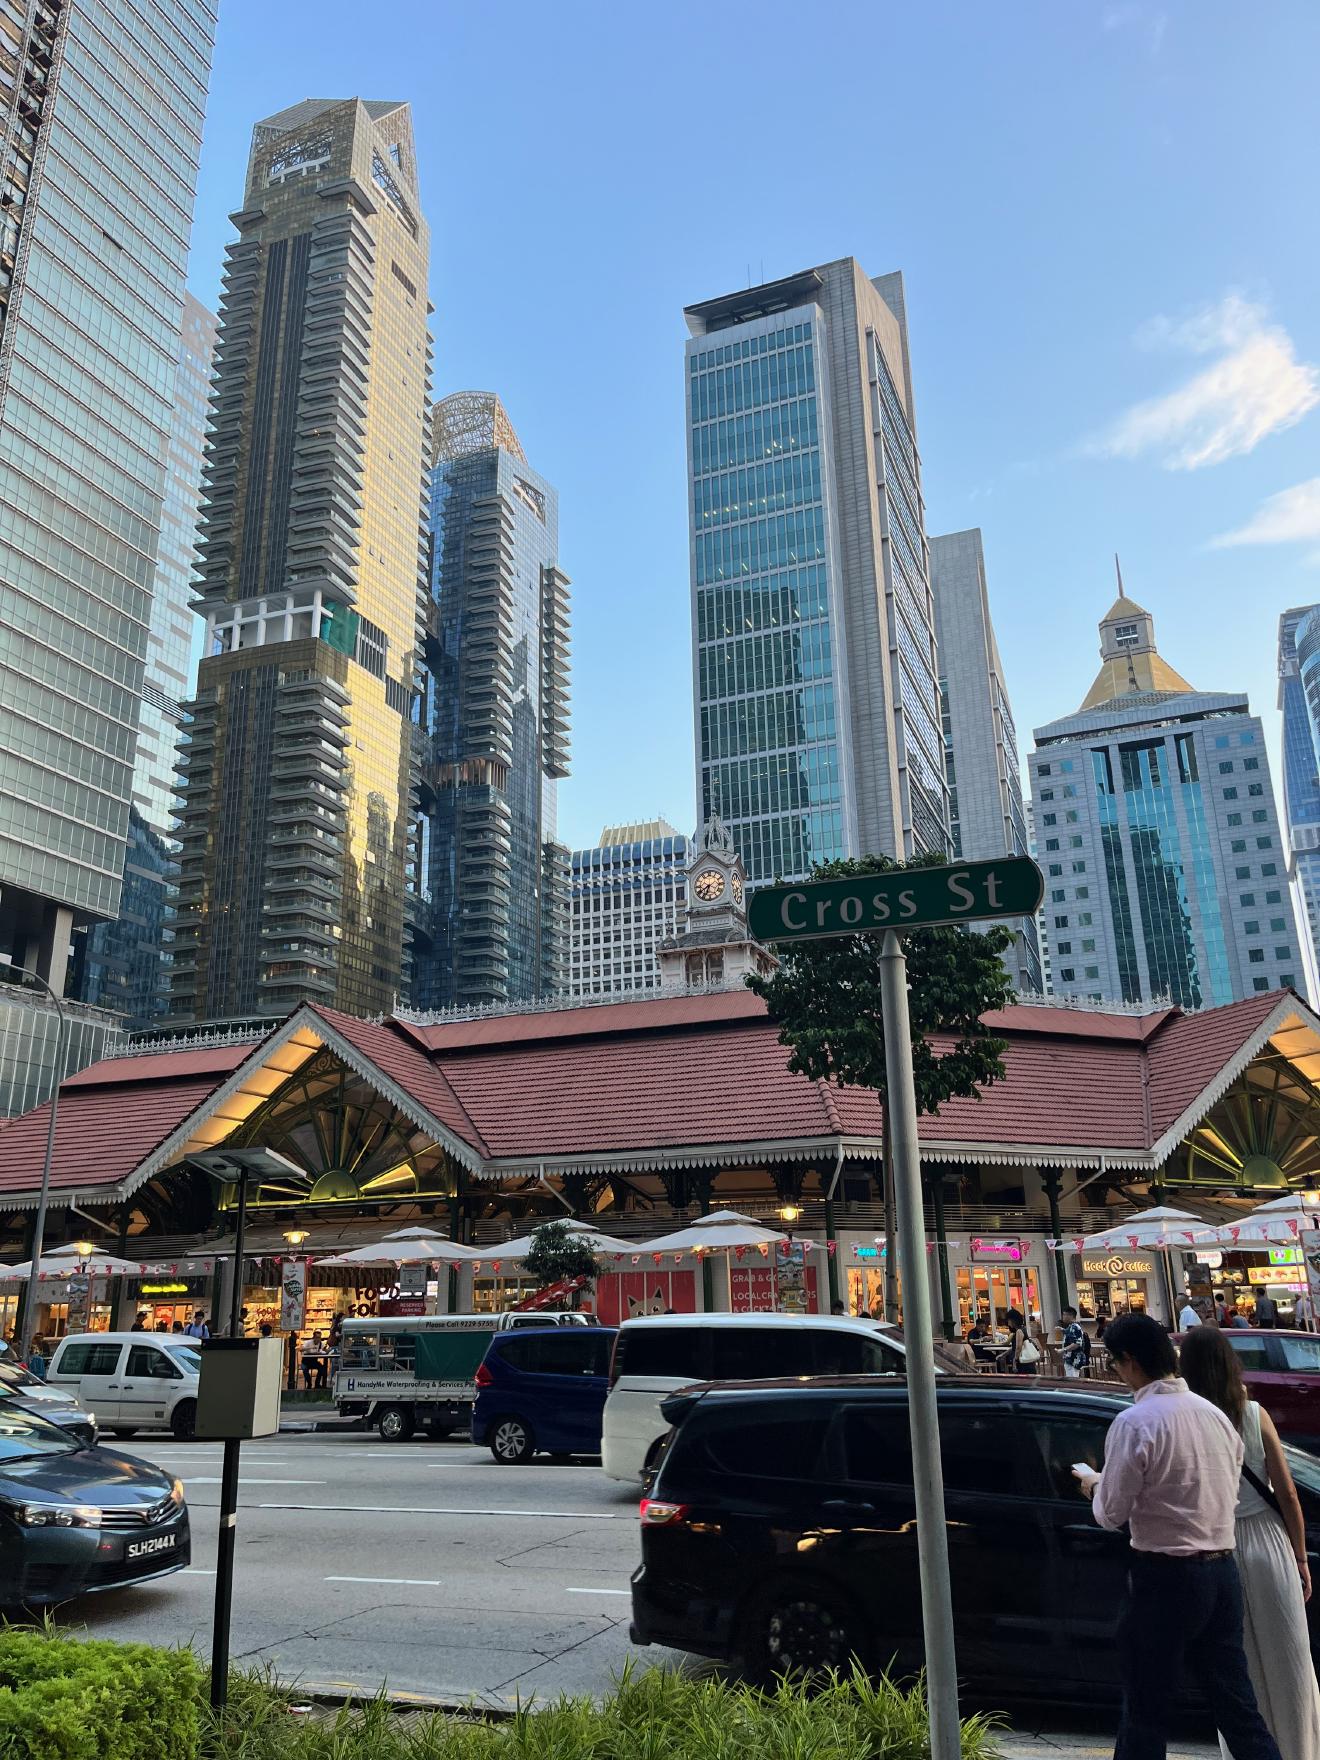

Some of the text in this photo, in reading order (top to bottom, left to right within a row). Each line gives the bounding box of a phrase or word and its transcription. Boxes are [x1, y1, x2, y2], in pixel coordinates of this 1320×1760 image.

[780, 871, 1004, 930] Cross St
[1084, 1260, 1152, 1272] Hook Coffee
[733, 1292, 760, 1301] LOCAL
[357, 1381, 385, 1389] HandyMe
[386, 1380, 430, 1389] Waterproofing
[128, 1534, 176, 1558] SLH2144X
